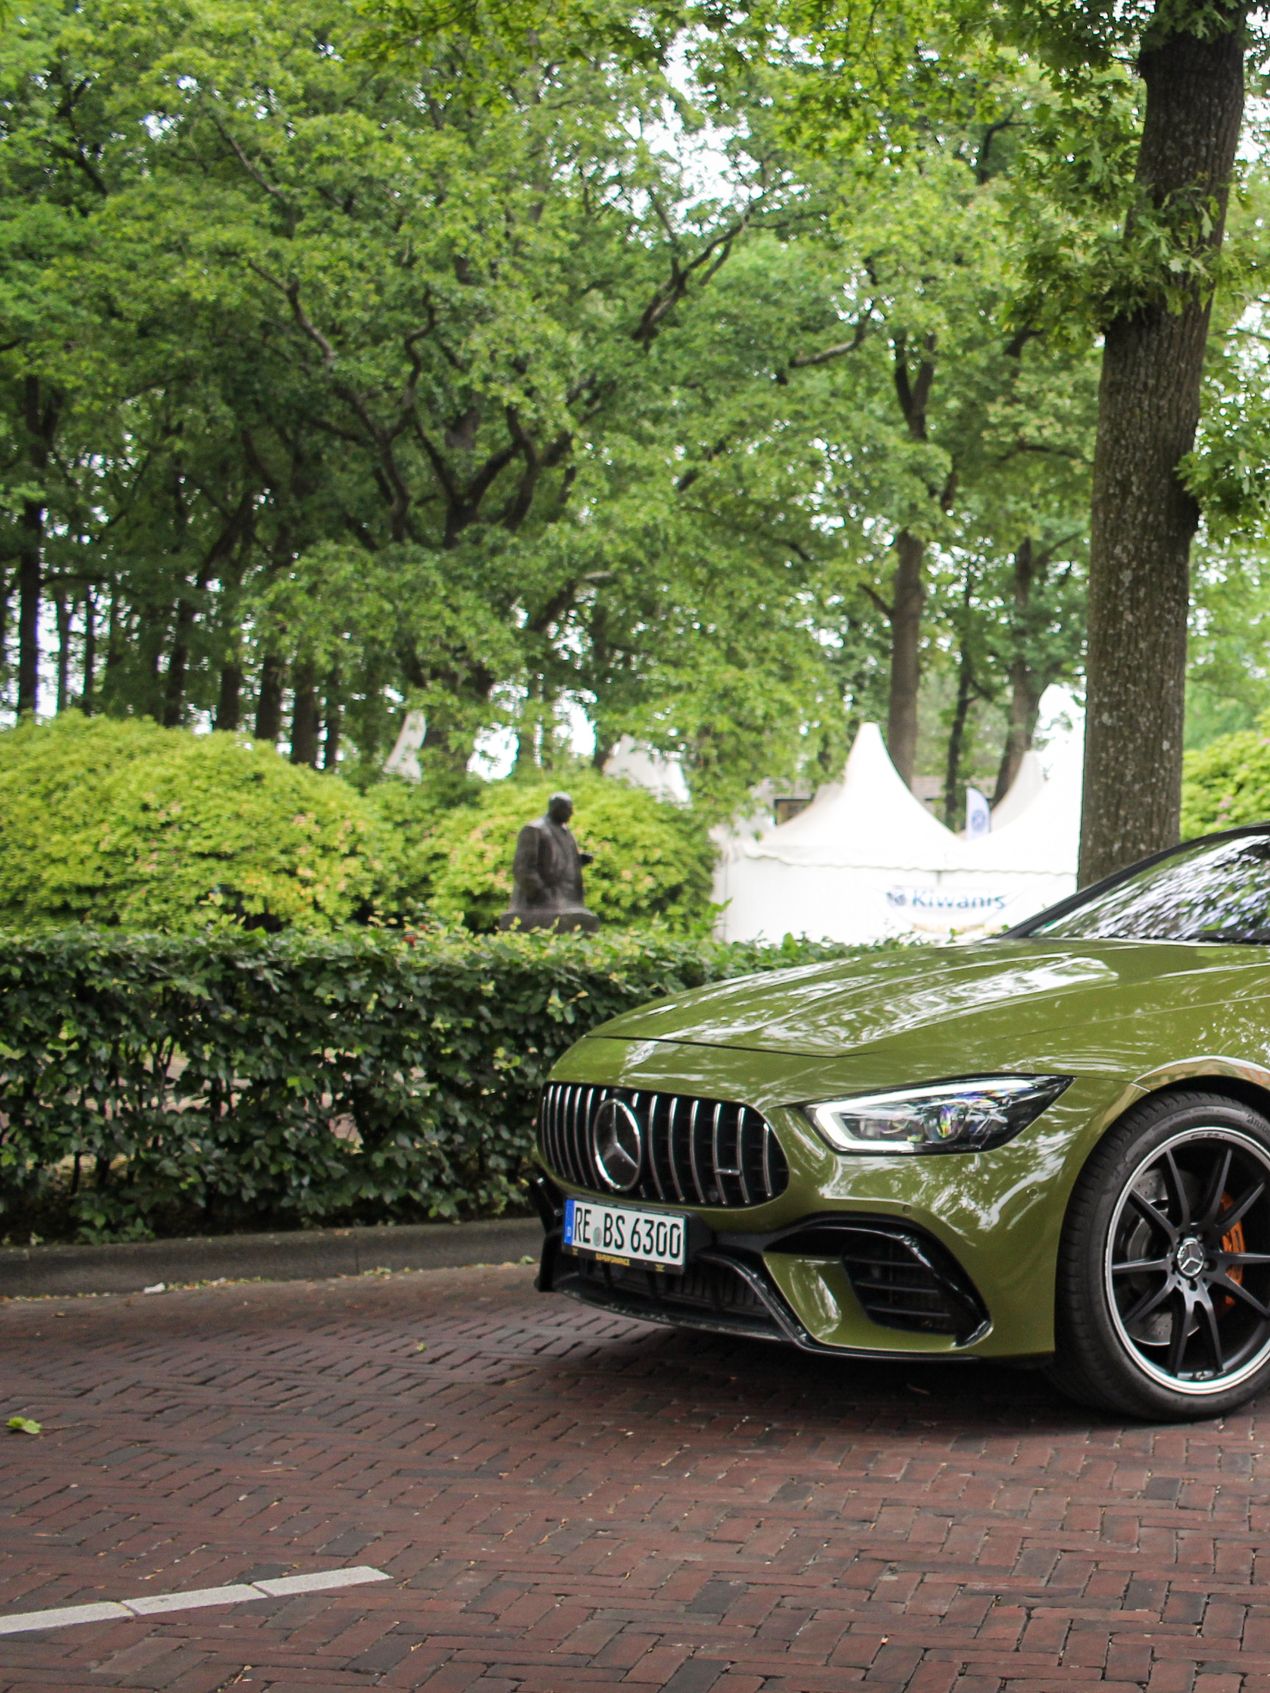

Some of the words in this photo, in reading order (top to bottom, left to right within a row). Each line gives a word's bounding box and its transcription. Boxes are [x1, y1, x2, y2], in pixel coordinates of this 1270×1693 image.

[912, 889, 1006, 909] Kiwanis
[574, 1206, 592, 1244] RE
[603, 1212, 625, 1250] BS
[631, 1217, 682, 1259] 6300
